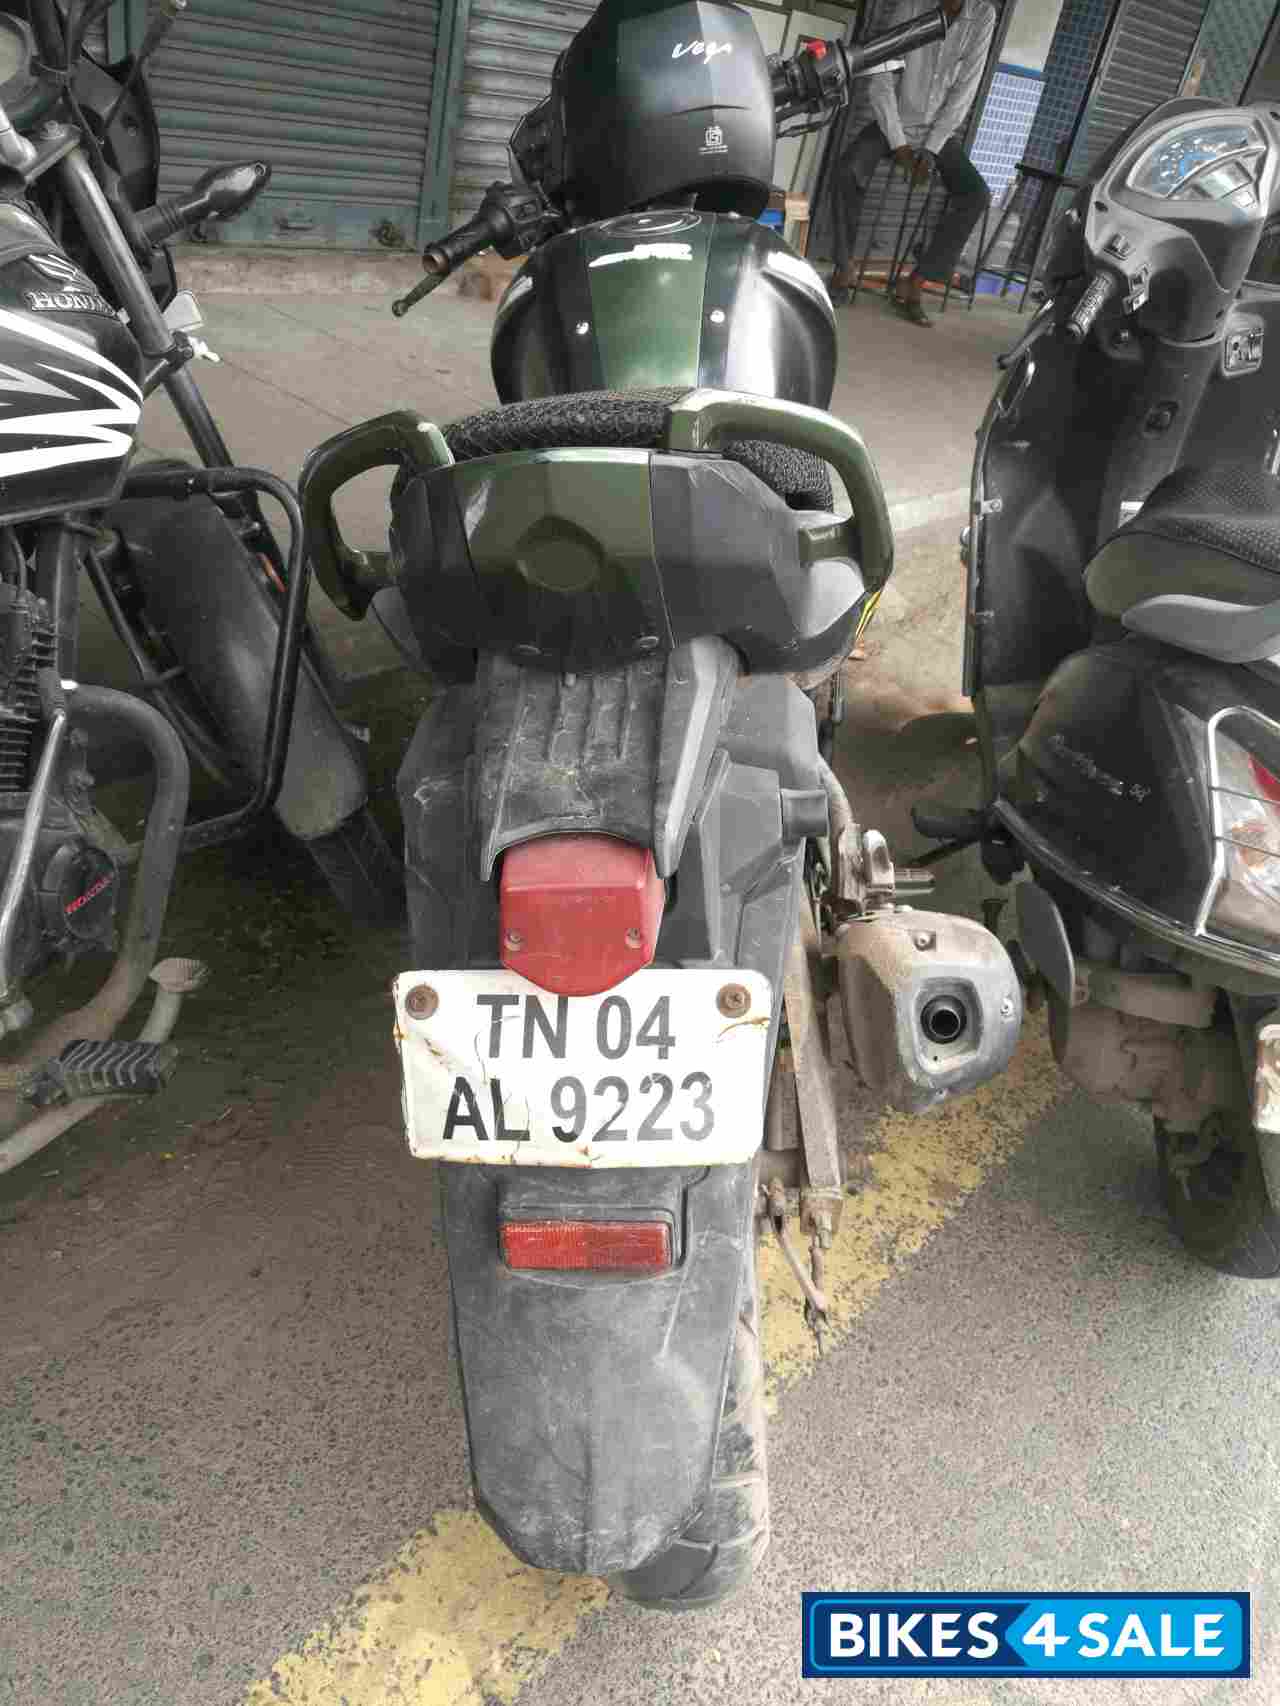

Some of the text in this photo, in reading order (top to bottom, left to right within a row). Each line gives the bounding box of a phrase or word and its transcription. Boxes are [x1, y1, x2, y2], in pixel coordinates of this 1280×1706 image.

[477, 994, 676, 1060] TN 04
[442, 1071, 715, 1143] AL 9223
